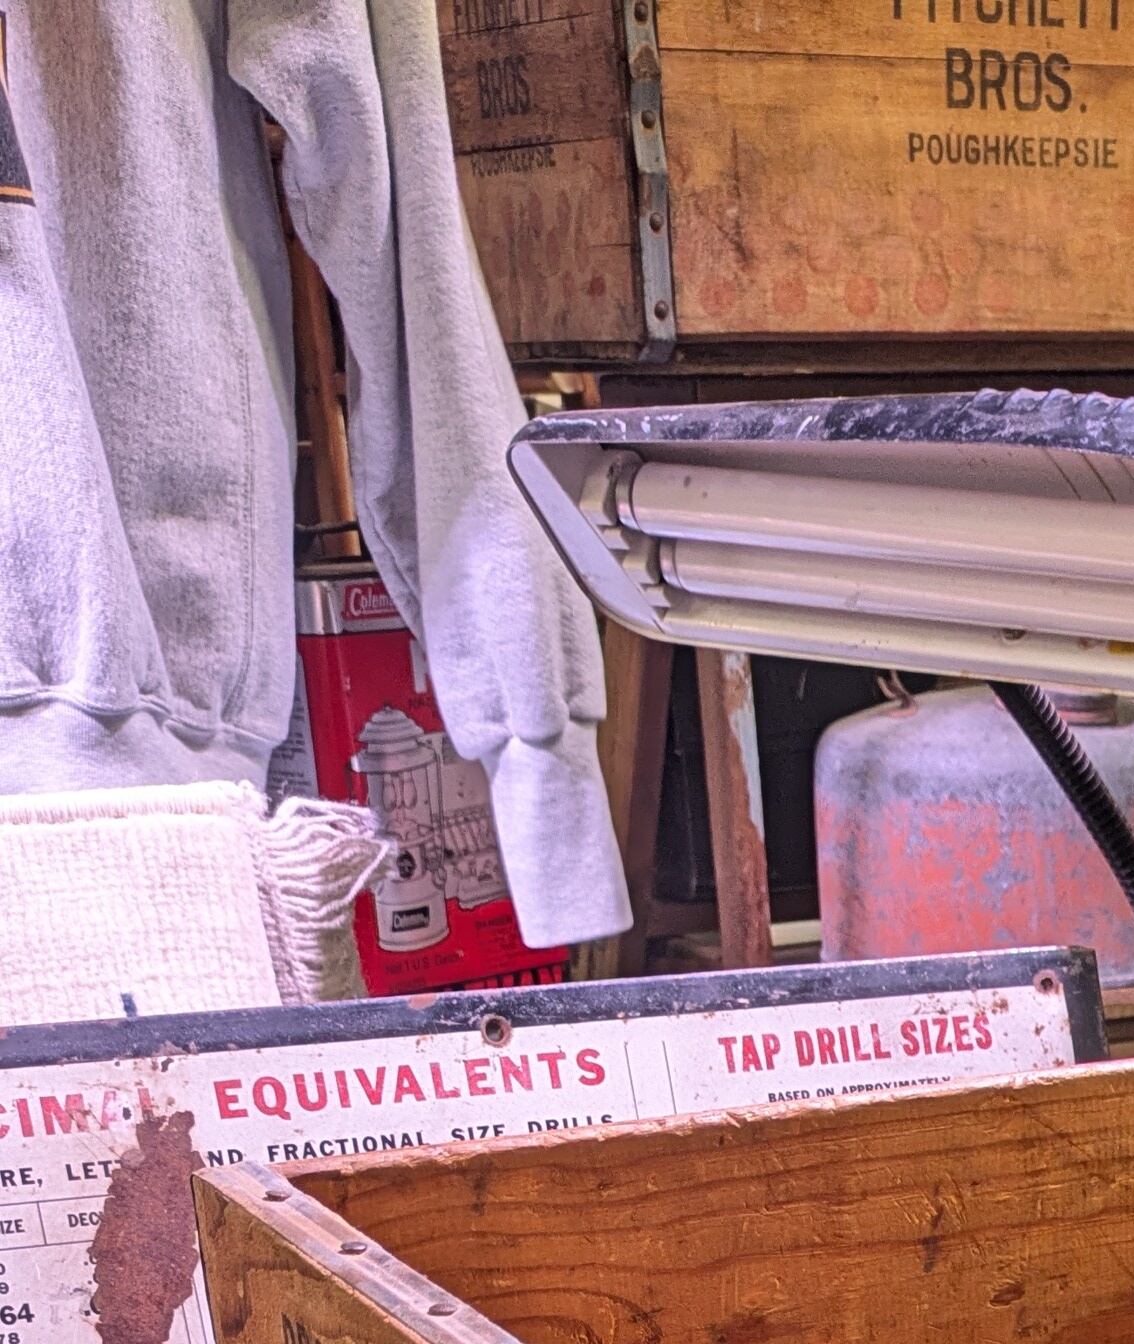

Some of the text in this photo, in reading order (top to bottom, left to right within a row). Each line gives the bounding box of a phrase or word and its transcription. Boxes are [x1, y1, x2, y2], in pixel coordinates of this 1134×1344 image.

[945, 47, 1087, 113] BROS.
[908, 132, 1120, 169] POUGHKEEPSIE
[718, 1014, 994, 1074] TAP DRILL SIZES
[213, 1049, 607, 1122] EQUIVALENTS
[767, 1090, 811, 1104] BASED
[266, 1131, 431, 1162] FRACTIONAL
